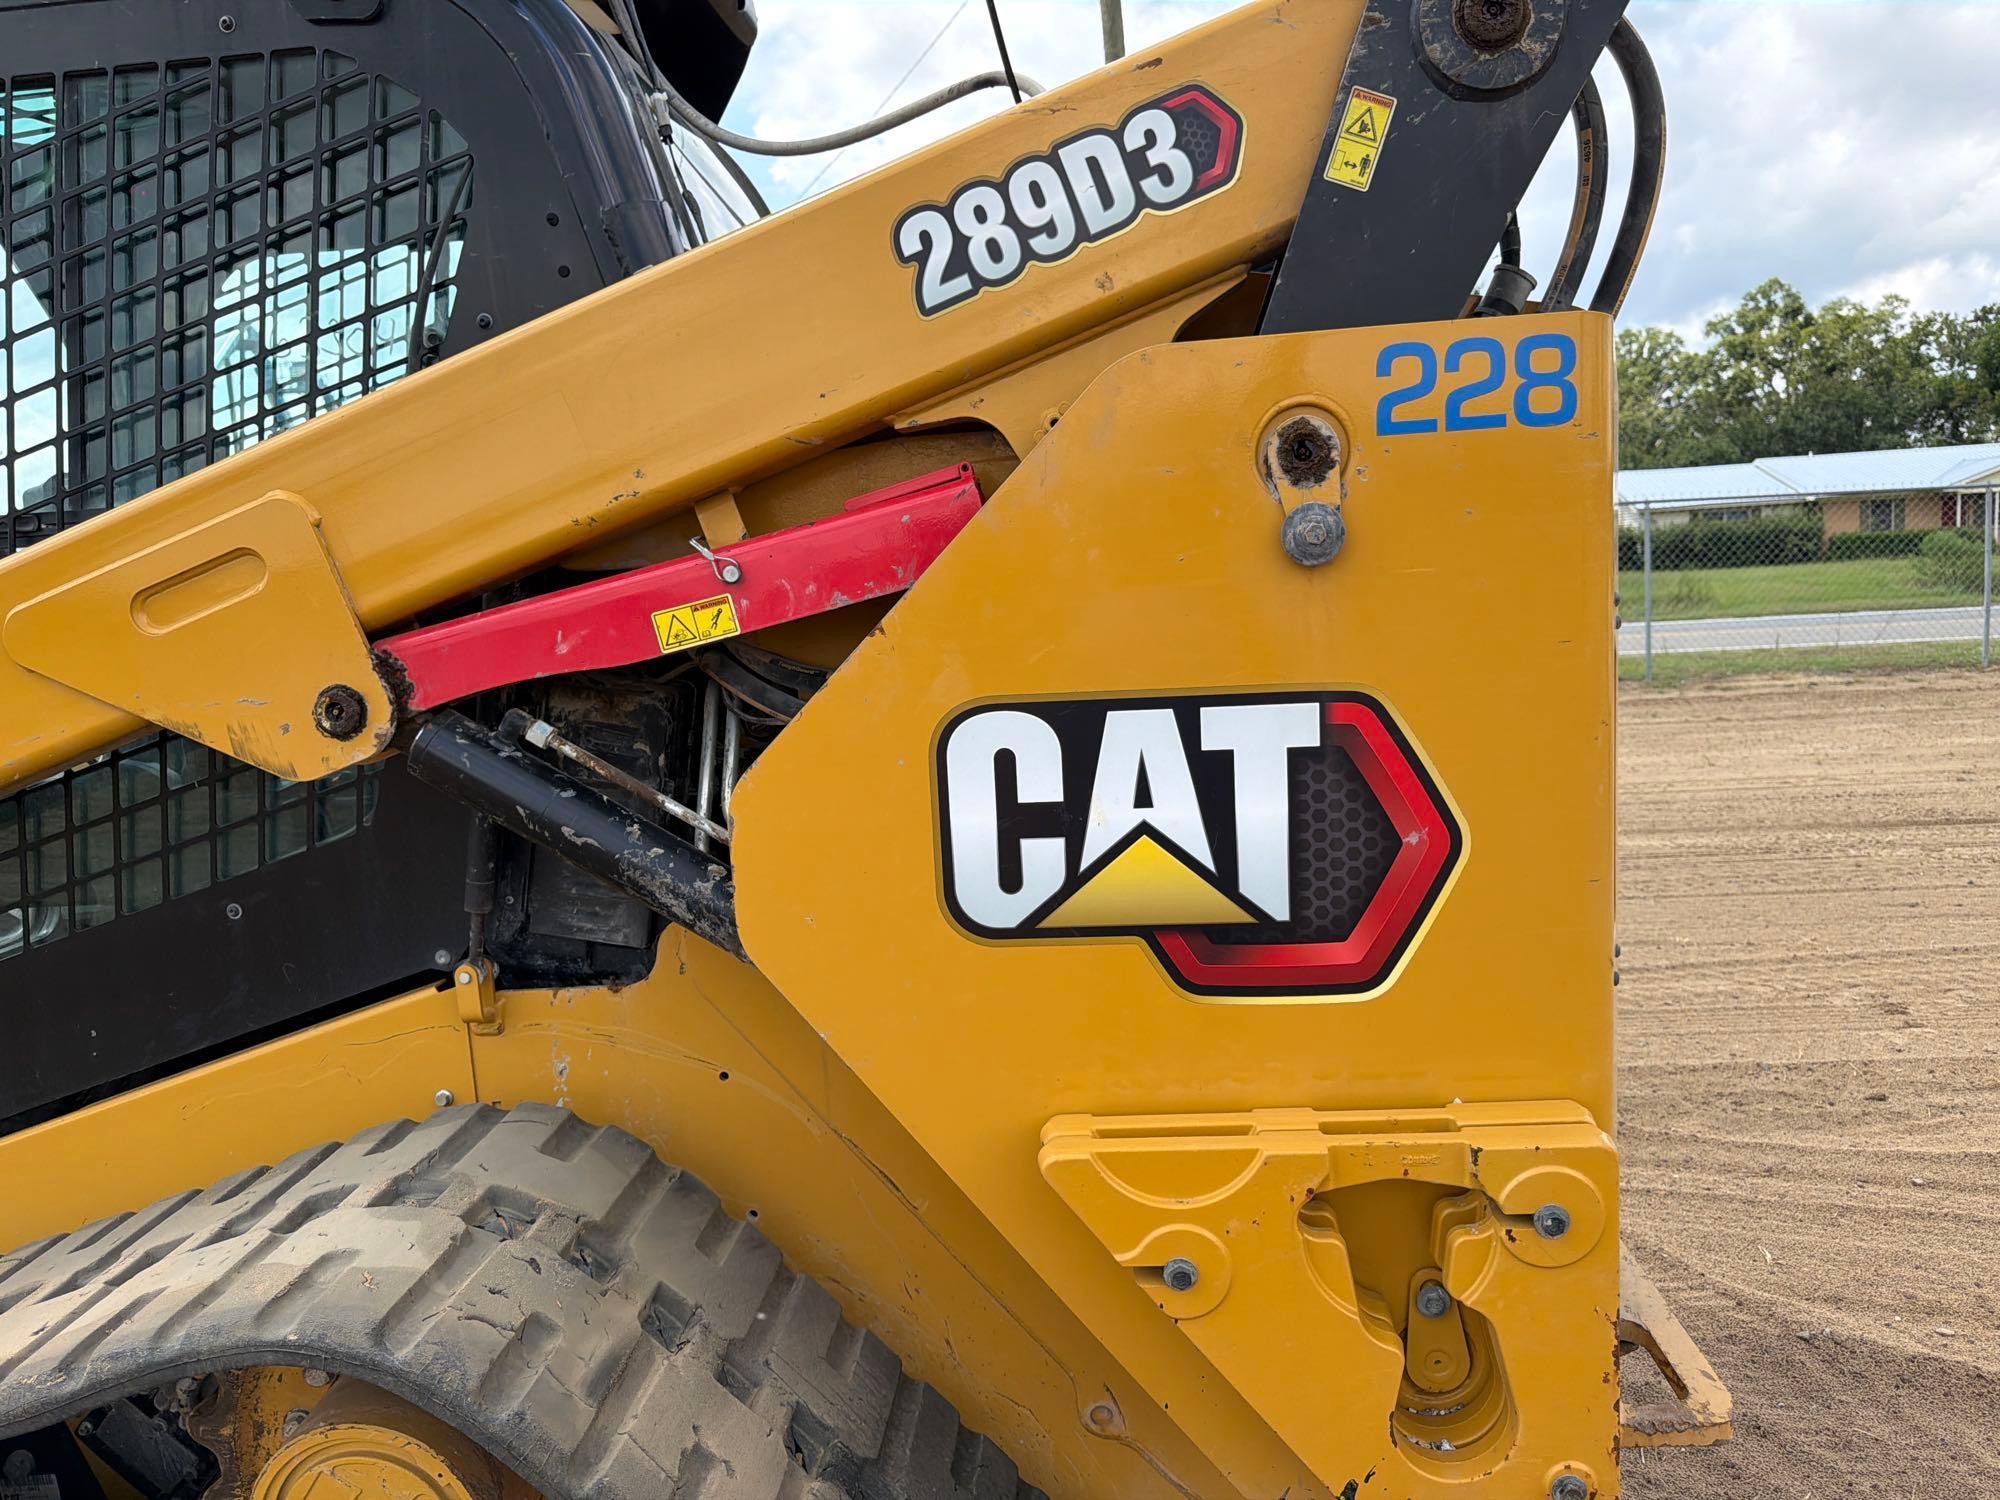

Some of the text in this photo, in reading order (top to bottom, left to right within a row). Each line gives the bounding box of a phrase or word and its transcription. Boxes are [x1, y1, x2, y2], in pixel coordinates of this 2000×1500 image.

[1360, 94, 1392, 108] WARNING
[899, 108, 1193, 310] 289D3
[1375, 333, 1578, 437] 228
[700, 598, 728, 611] WARNING
[945, 702, 1321, 929] CAT
